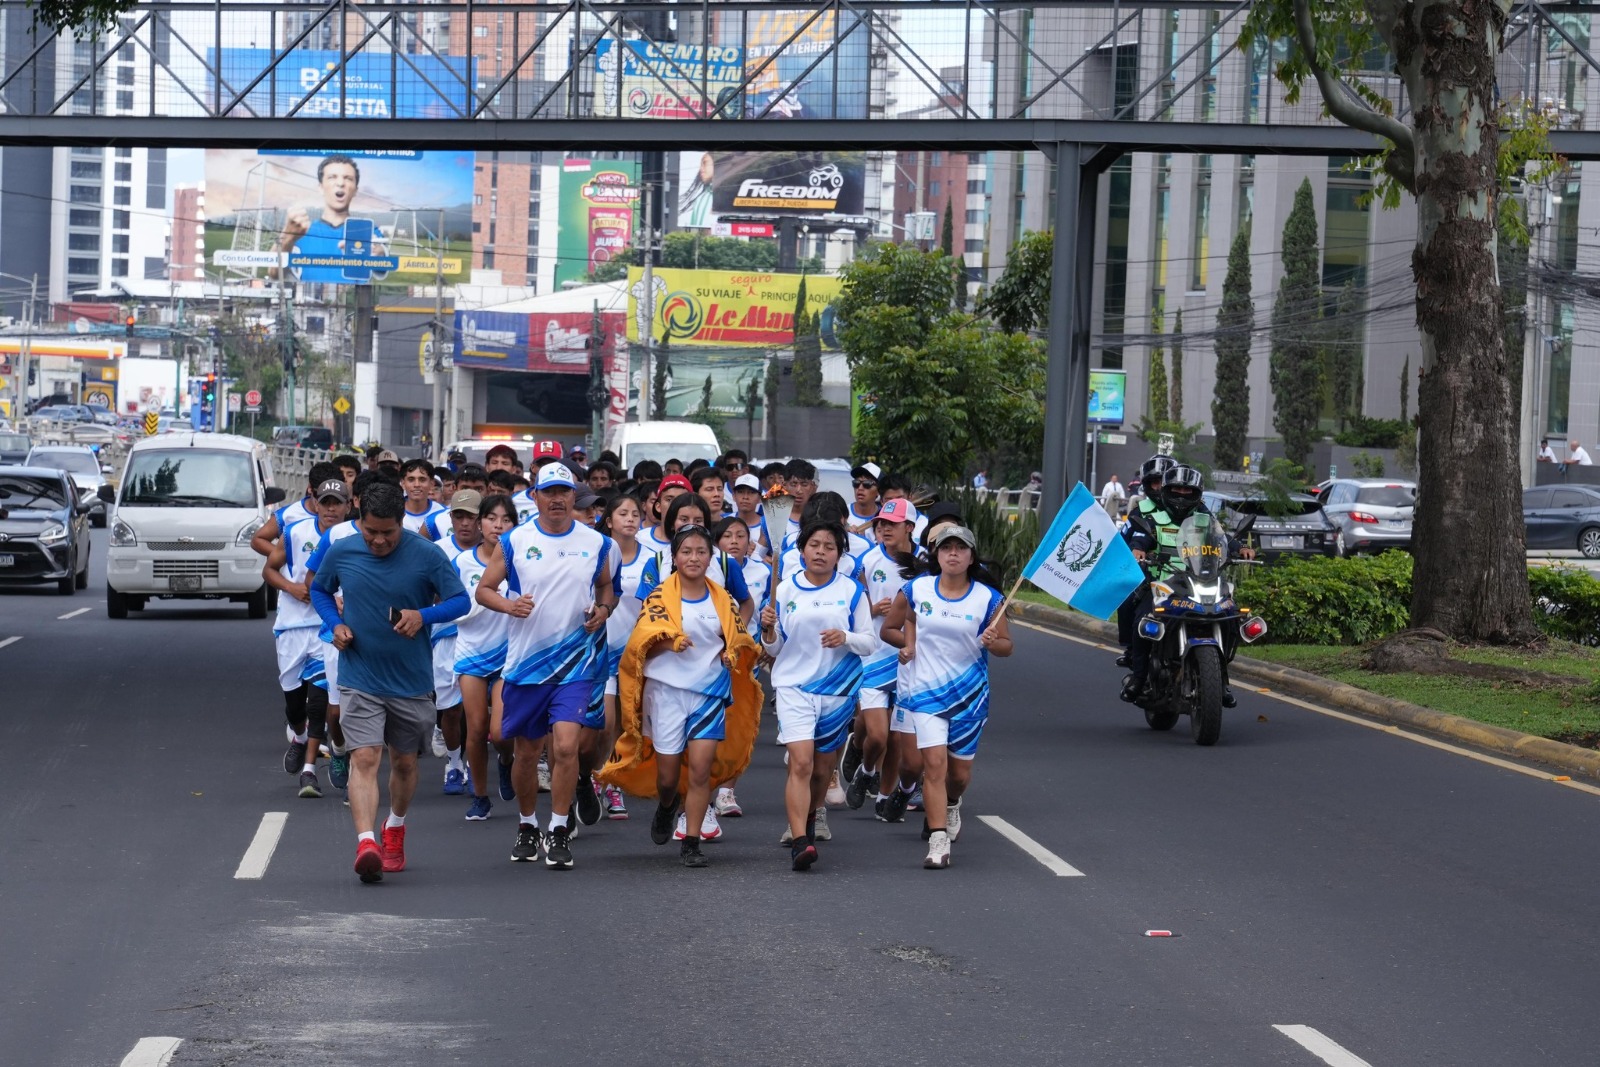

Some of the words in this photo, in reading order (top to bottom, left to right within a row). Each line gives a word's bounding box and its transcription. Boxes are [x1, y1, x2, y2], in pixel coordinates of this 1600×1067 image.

[646, 41, 740, 63] CENTRO
[748, 47, 761, 58] EN
[764, 44, 789, 56] TOO
[793, 41, 835, 55] TERREN
[635, 60, 742, 81] MICHELIN
[737, 179, 841, 199] FREEDOM
[291, 257, 311, 265] cada
[312, 258, 362, 267] movimiento
[730, 274, 772, 288] seguro
[696, 288, 710, 297] SU
[712, 289, 741, 299] VIAJE
[761, 291, 798, 302] PRINCIP
[705, 303, 737, 328] Le
[738, 305, 796, 330] Man
[1182, 546, 1200, 558] PNC
